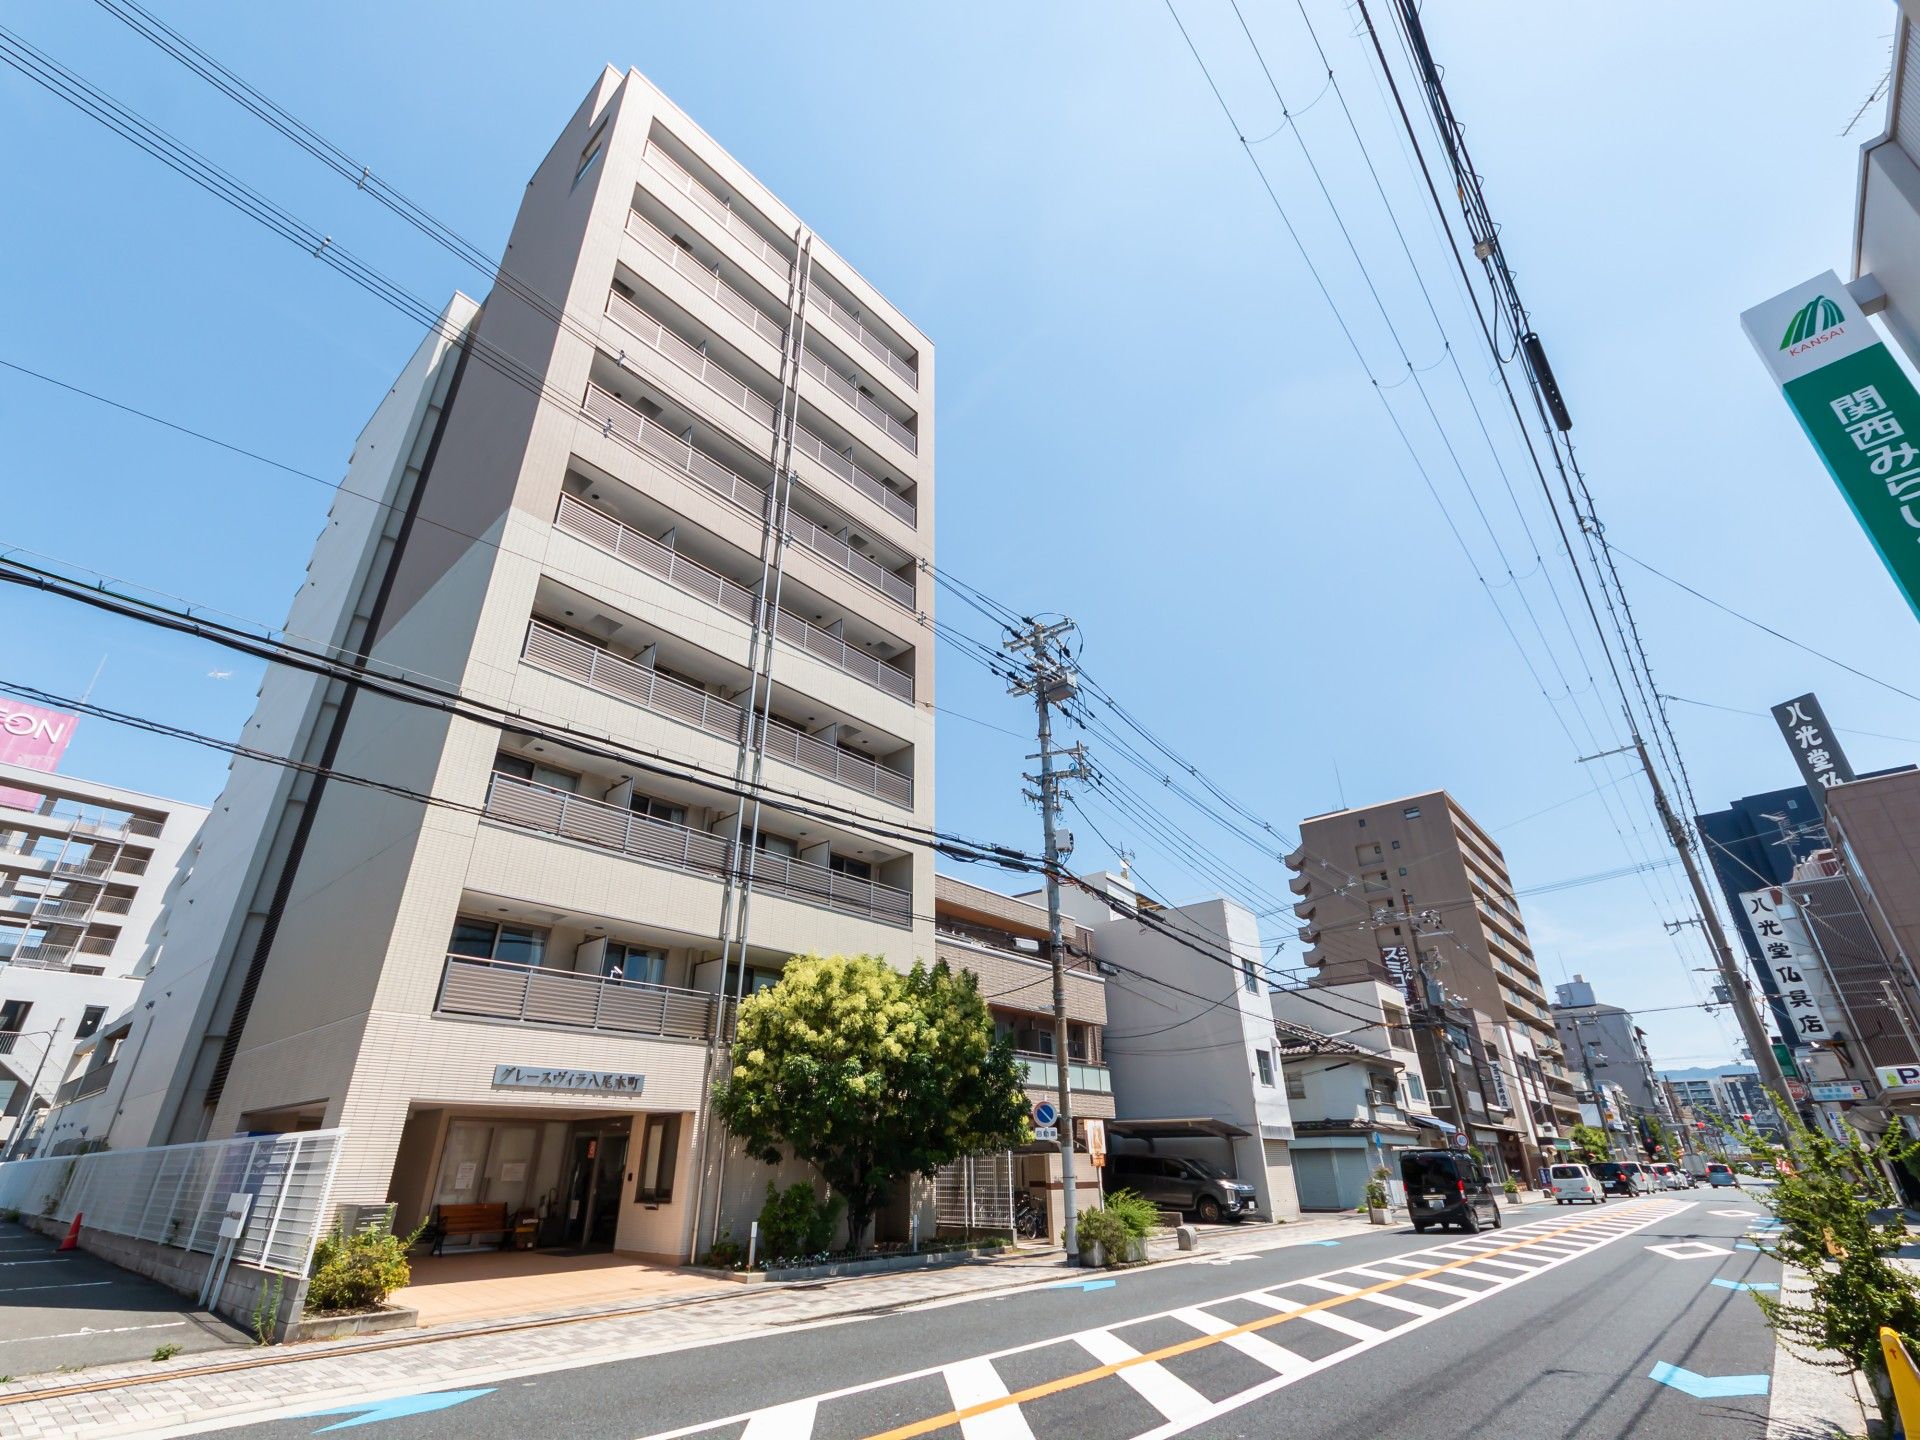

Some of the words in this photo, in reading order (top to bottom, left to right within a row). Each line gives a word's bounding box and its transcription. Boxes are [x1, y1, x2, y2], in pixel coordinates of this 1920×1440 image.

[1790, 327, 1844, 357] KANSAI
[1751, 898, 1824, 1034] 八光堂仏具店
[1896, 1068, 1919, 1084] P
